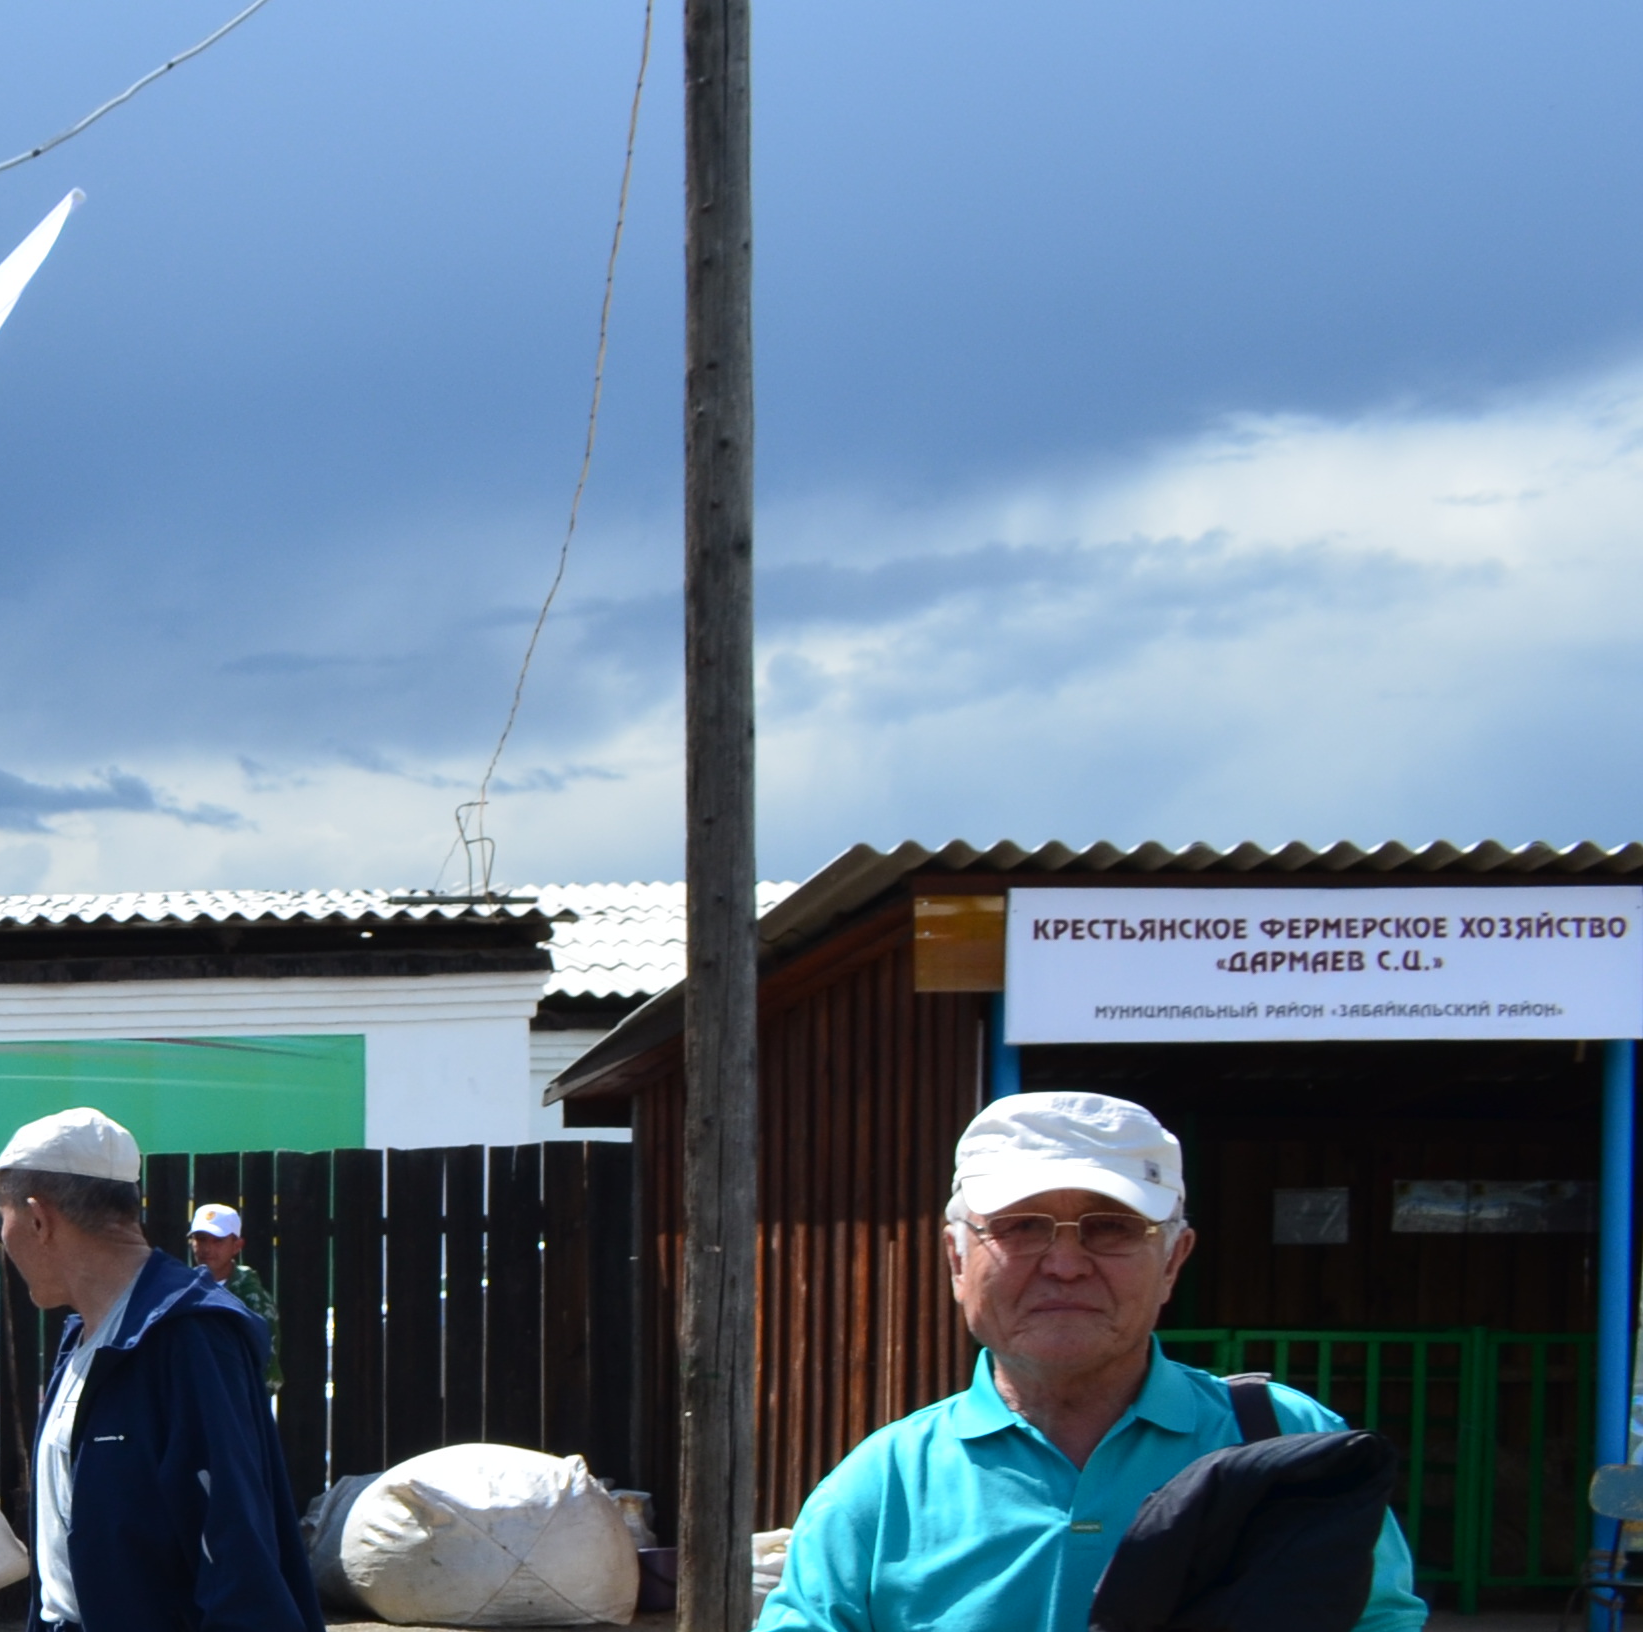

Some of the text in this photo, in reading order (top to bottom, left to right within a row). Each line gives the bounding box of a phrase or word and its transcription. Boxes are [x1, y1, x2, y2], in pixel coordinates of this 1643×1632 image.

[1032, 911, 1628, 942] КРЕСТЬЯНСКОЕ ФЕРМЕРСКОЕ ХОЗЯЙСТВО
[1215, 950, 1366, 974] «ДАРМАЕВ
[1094, 999, 1565, 1020] МУНИЦИПАЛЬНЫЙ РАЙОН «ЗАБАЙКАЛЬСКИЙ РАЙОН»
